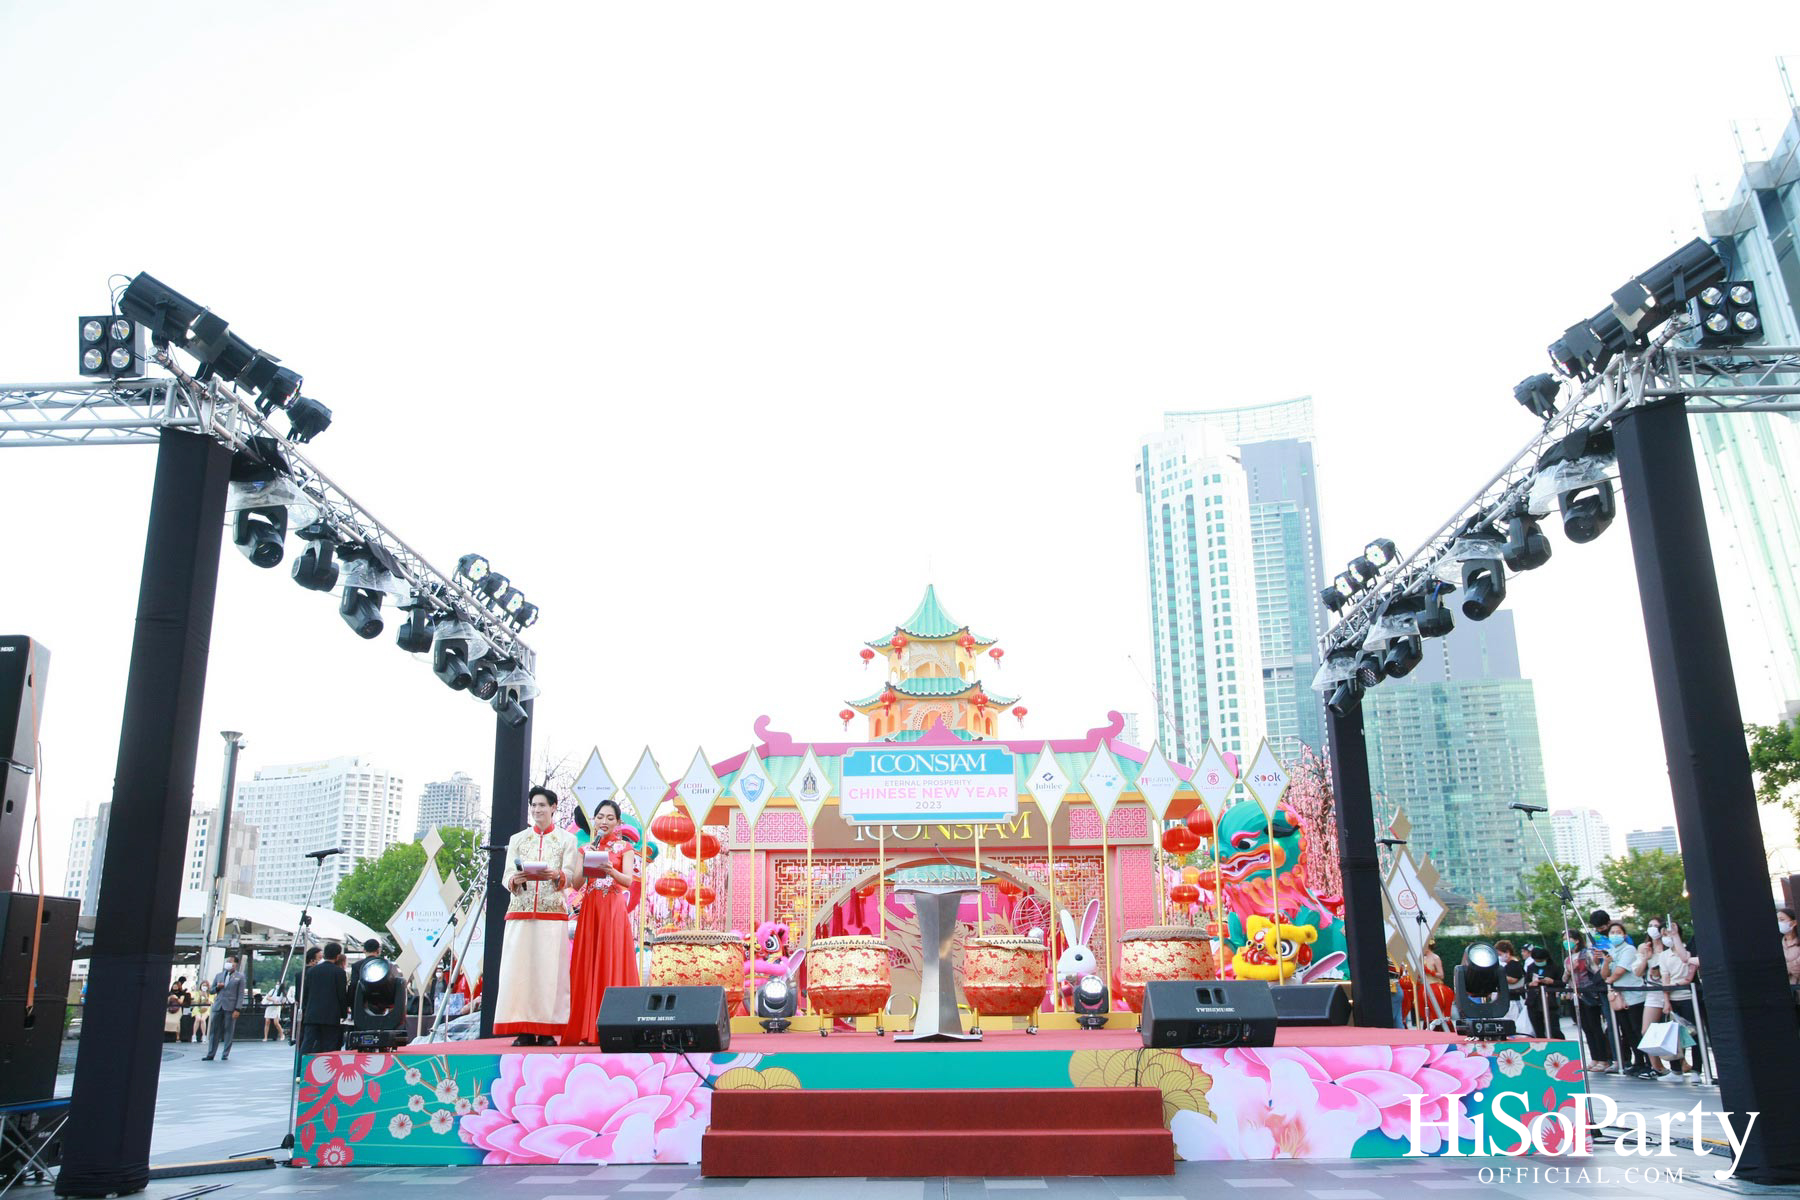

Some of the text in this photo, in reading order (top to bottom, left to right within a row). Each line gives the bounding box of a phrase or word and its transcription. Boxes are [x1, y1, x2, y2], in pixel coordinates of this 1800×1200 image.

[869, 753, 987, 774] ICONSIAM
[848, 786, 1009, 799] CHINESE NEW YEAR
[915, 801, 942, 810] 2023
